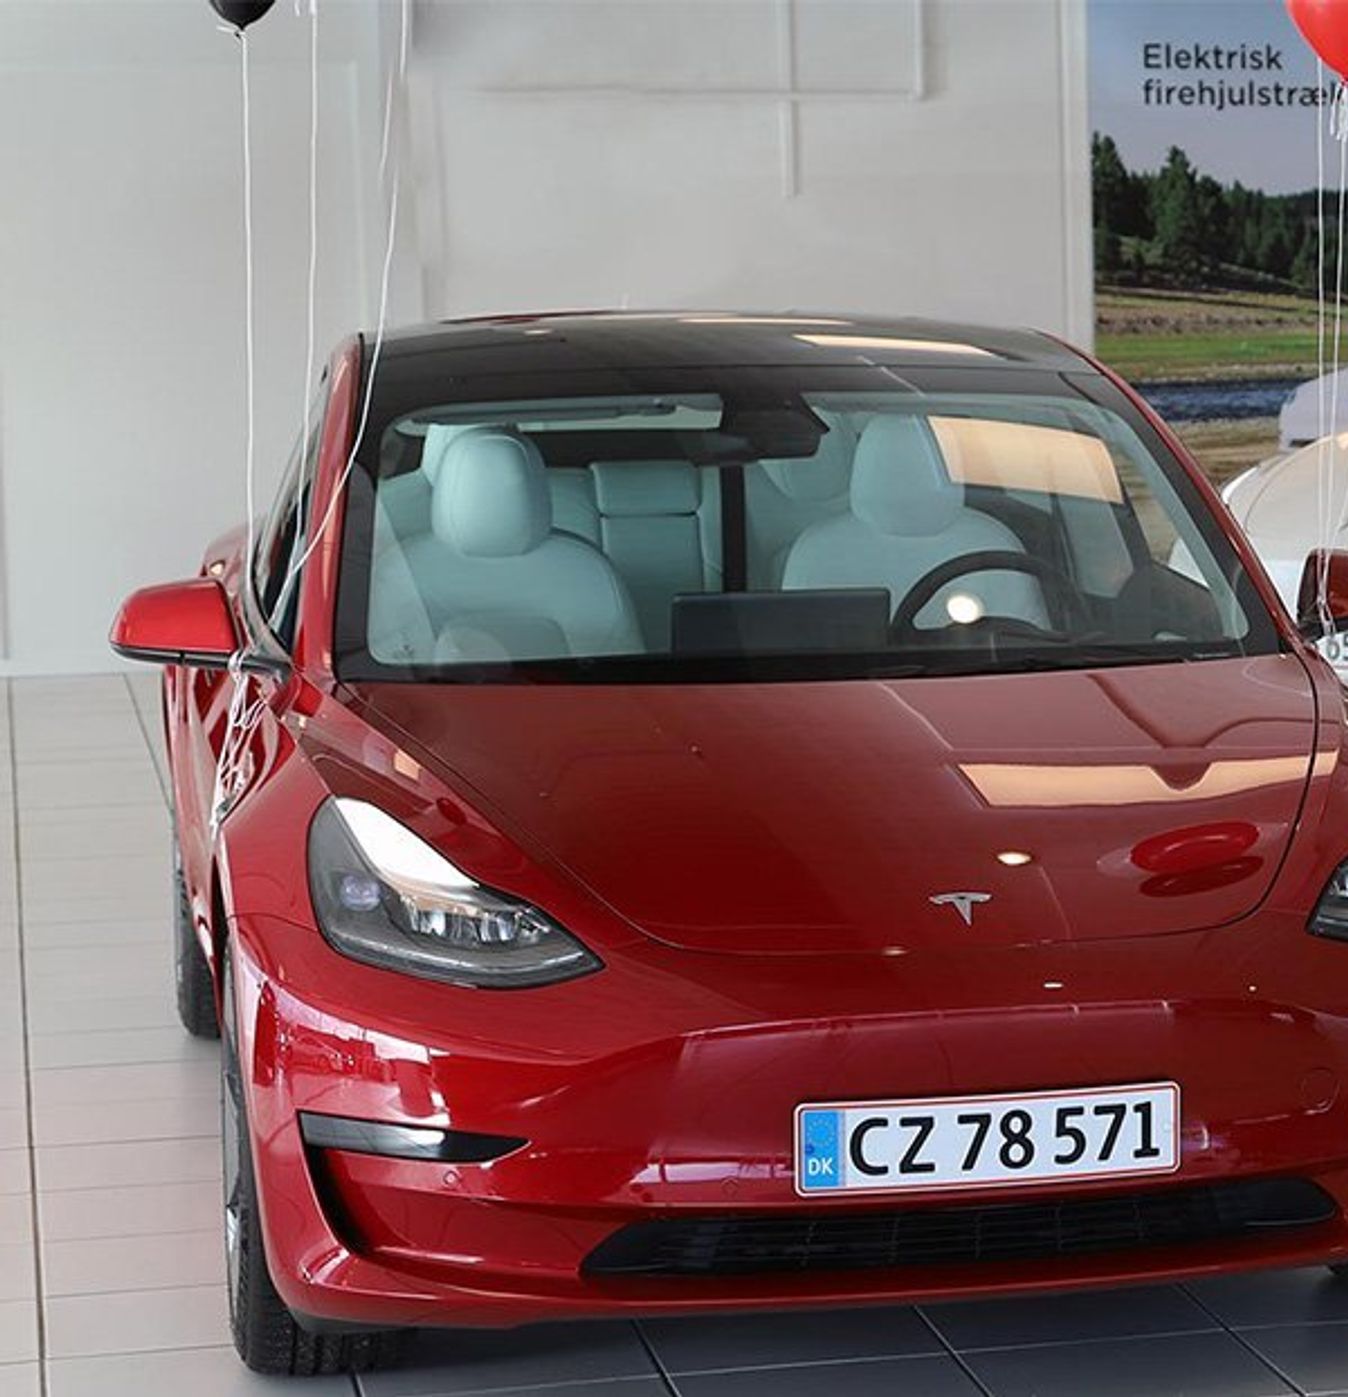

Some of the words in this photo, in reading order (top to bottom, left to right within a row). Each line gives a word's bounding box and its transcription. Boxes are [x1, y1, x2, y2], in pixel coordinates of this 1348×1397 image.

[1143, 43, 1283, 70] Elektrisk
[848, 1116, 936, 1177] CZ
[957, 1108, 1036, 1172] 78
[1054, 1100, 1161, 1166] 571
[807, 1157, 834, 1176] DK
